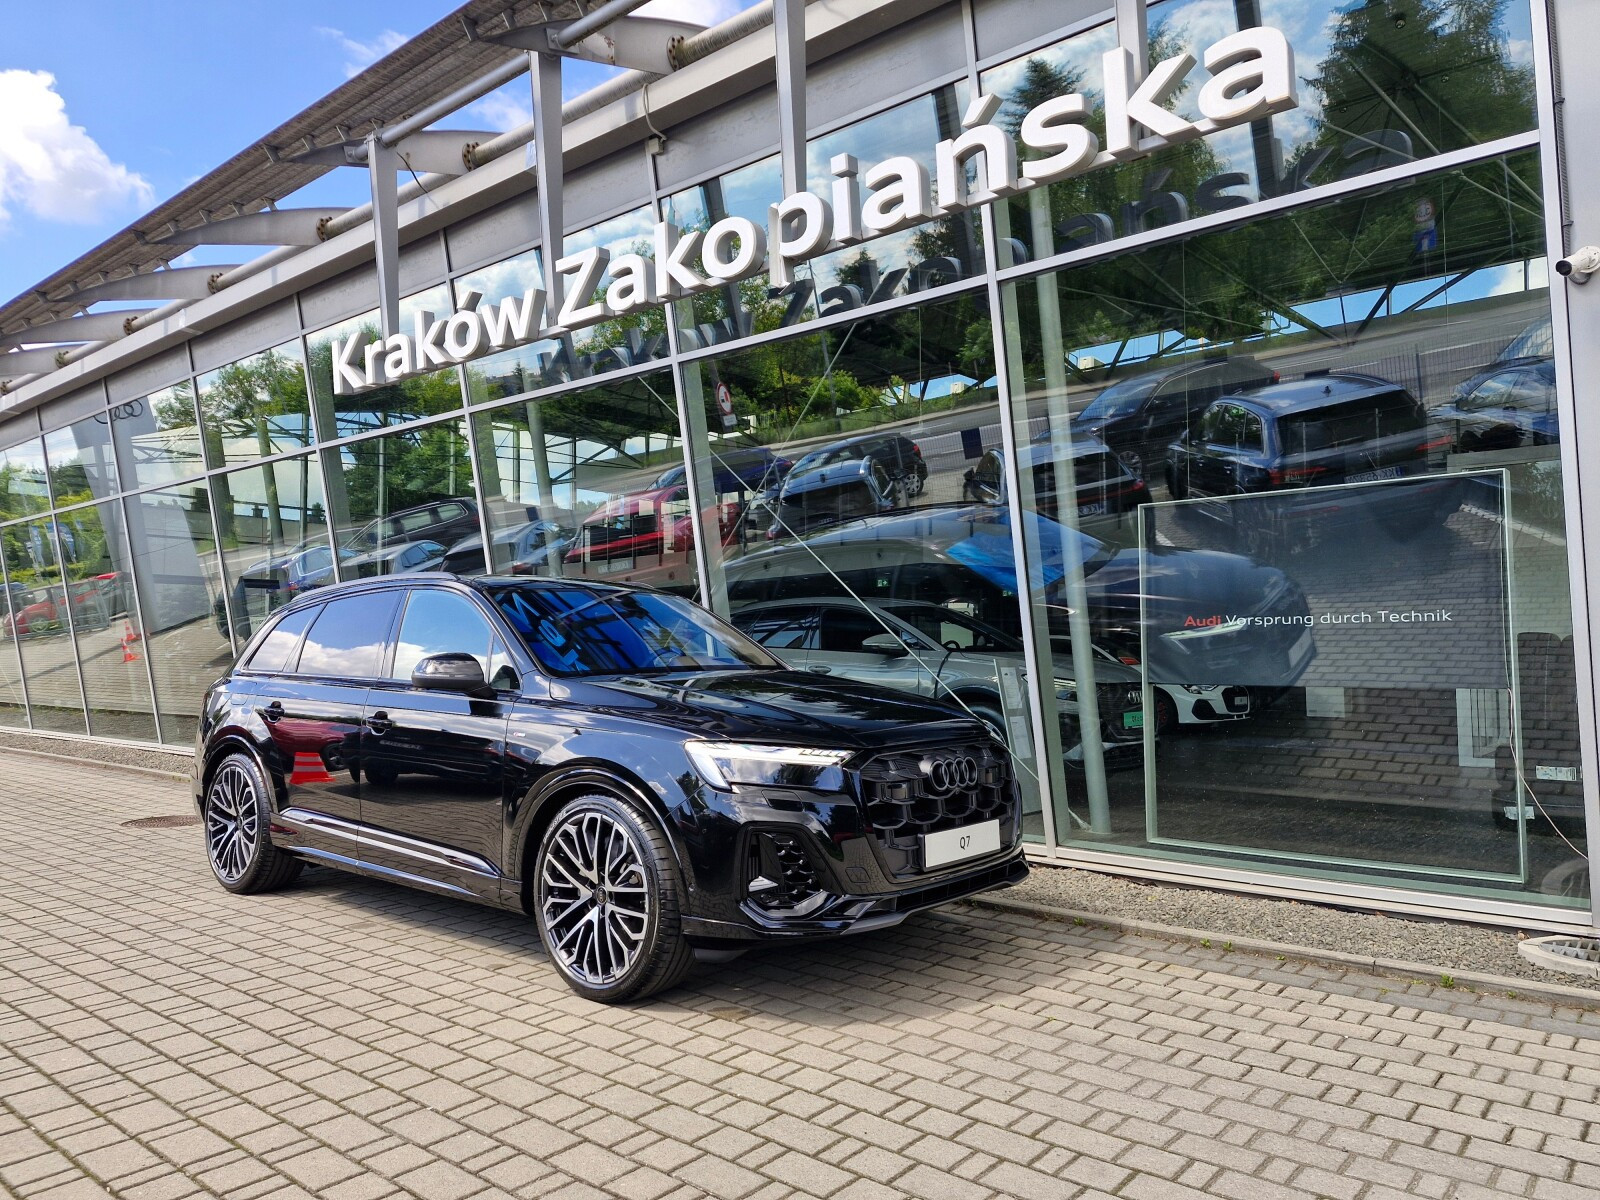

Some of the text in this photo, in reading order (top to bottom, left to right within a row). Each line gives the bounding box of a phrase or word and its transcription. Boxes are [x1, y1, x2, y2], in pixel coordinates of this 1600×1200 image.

[331, 288, 548, 395] Kraków
[555, 26, 1298, 328] Zakopiańska
[1184, 609, 1453, 628] Audi Vorsprung durch Technik
[959, 835, 971, 850] Q7
